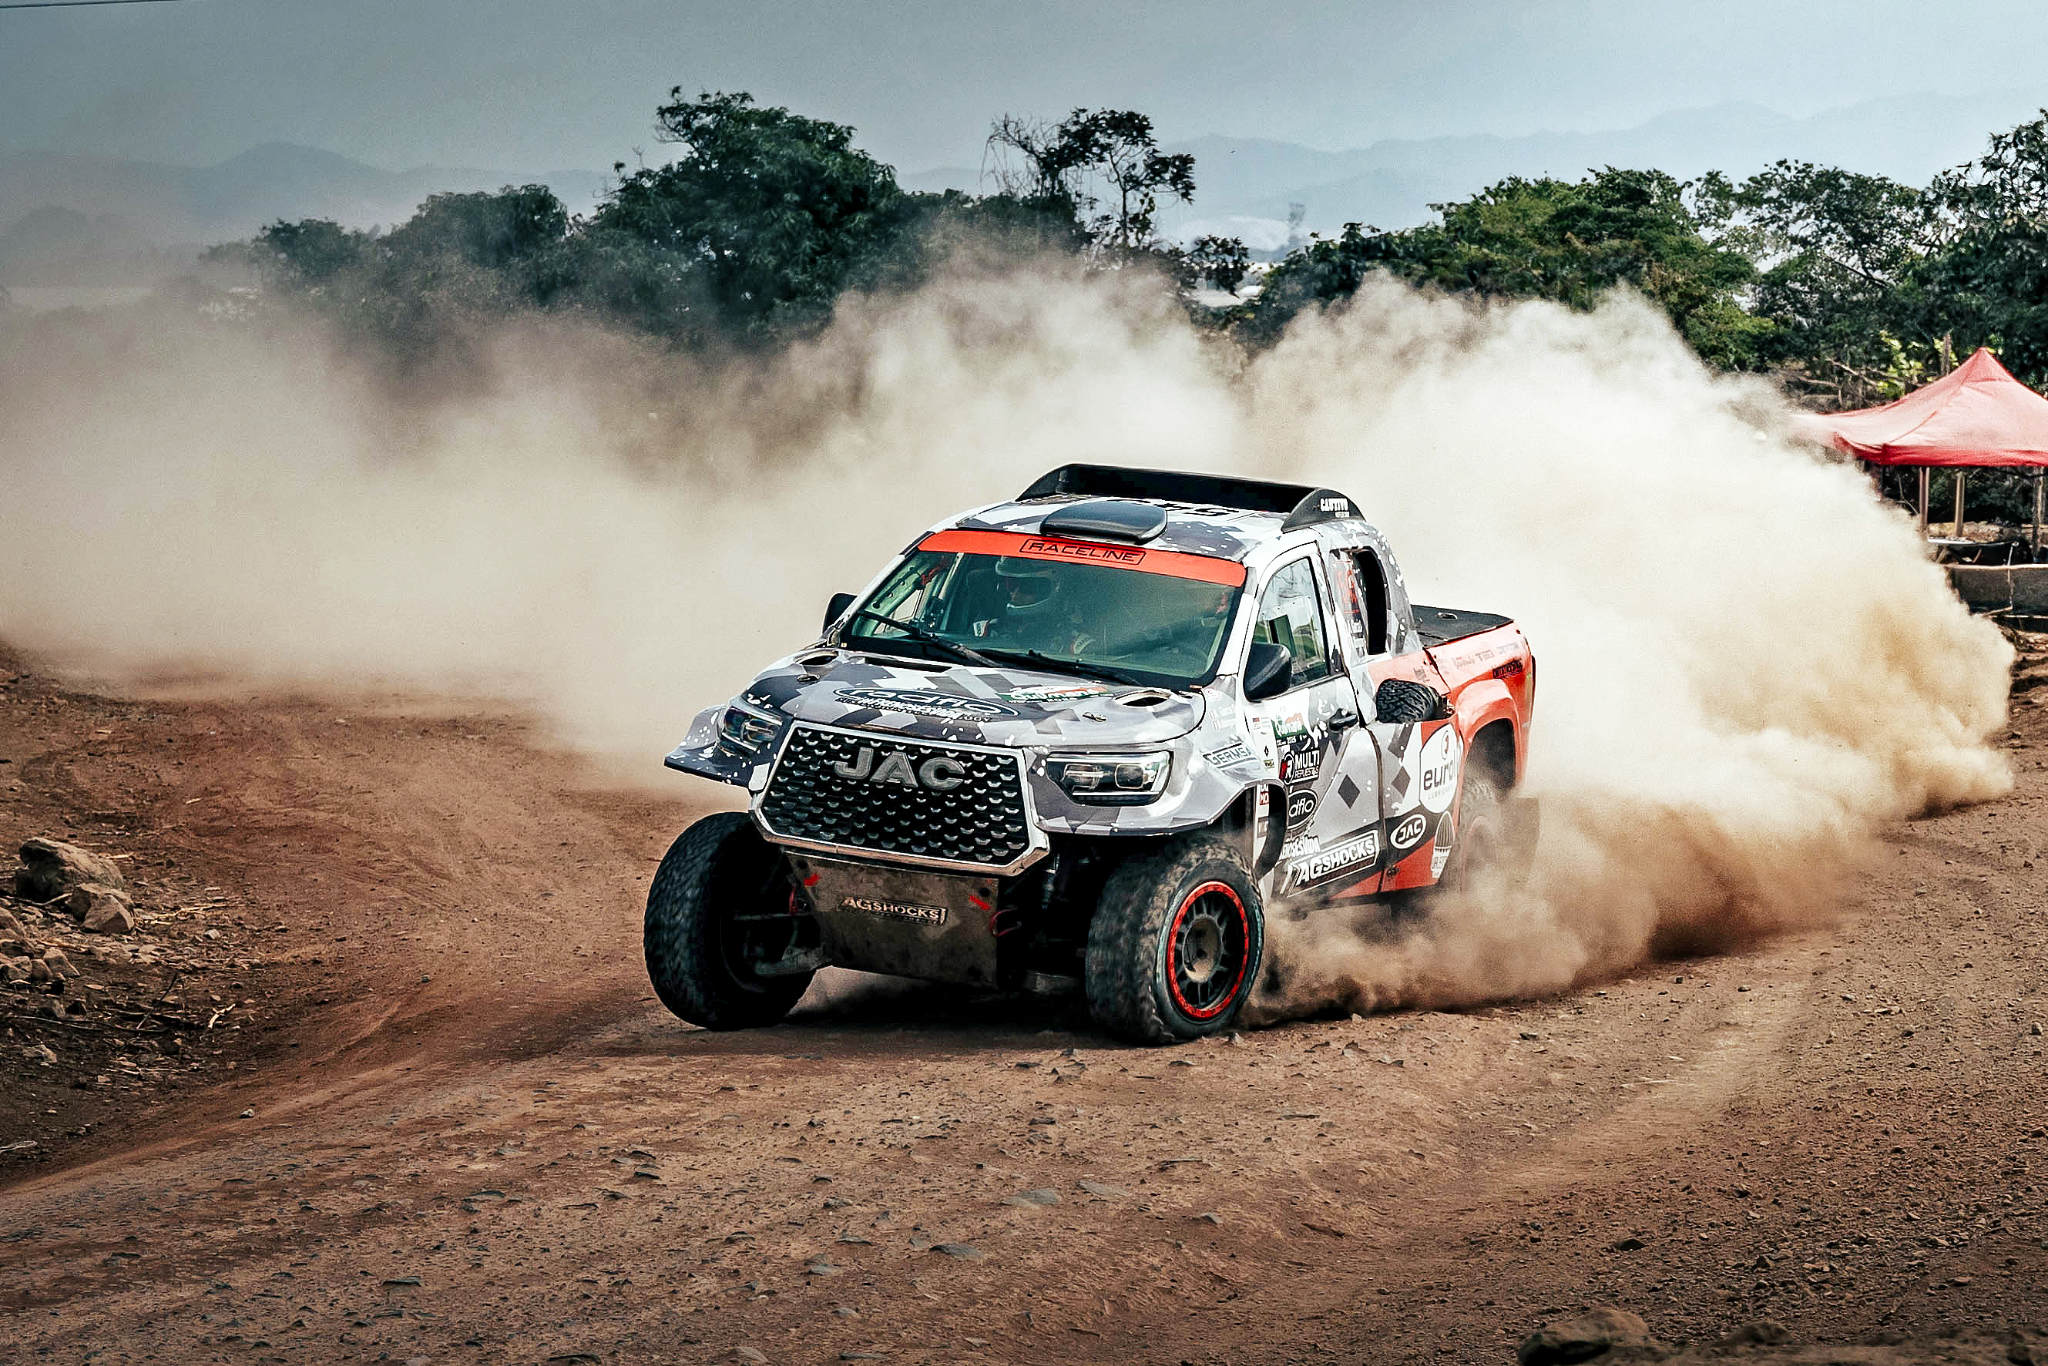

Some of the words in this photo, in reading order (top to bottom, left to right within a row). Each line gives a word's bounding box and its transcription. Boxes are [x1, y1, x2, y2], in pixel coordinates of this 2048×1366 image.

[1028, 541, 1140, 562] RACELINE
[834, 746, 966, 791] JAC
[1294, 750, 1320, 770] MULTI
[1399, 818, 1423, 841] JAC
[1296, 839, 1376, 887] AGSHOCKS
[840, 896, 940, 921] AGSHOCKS
